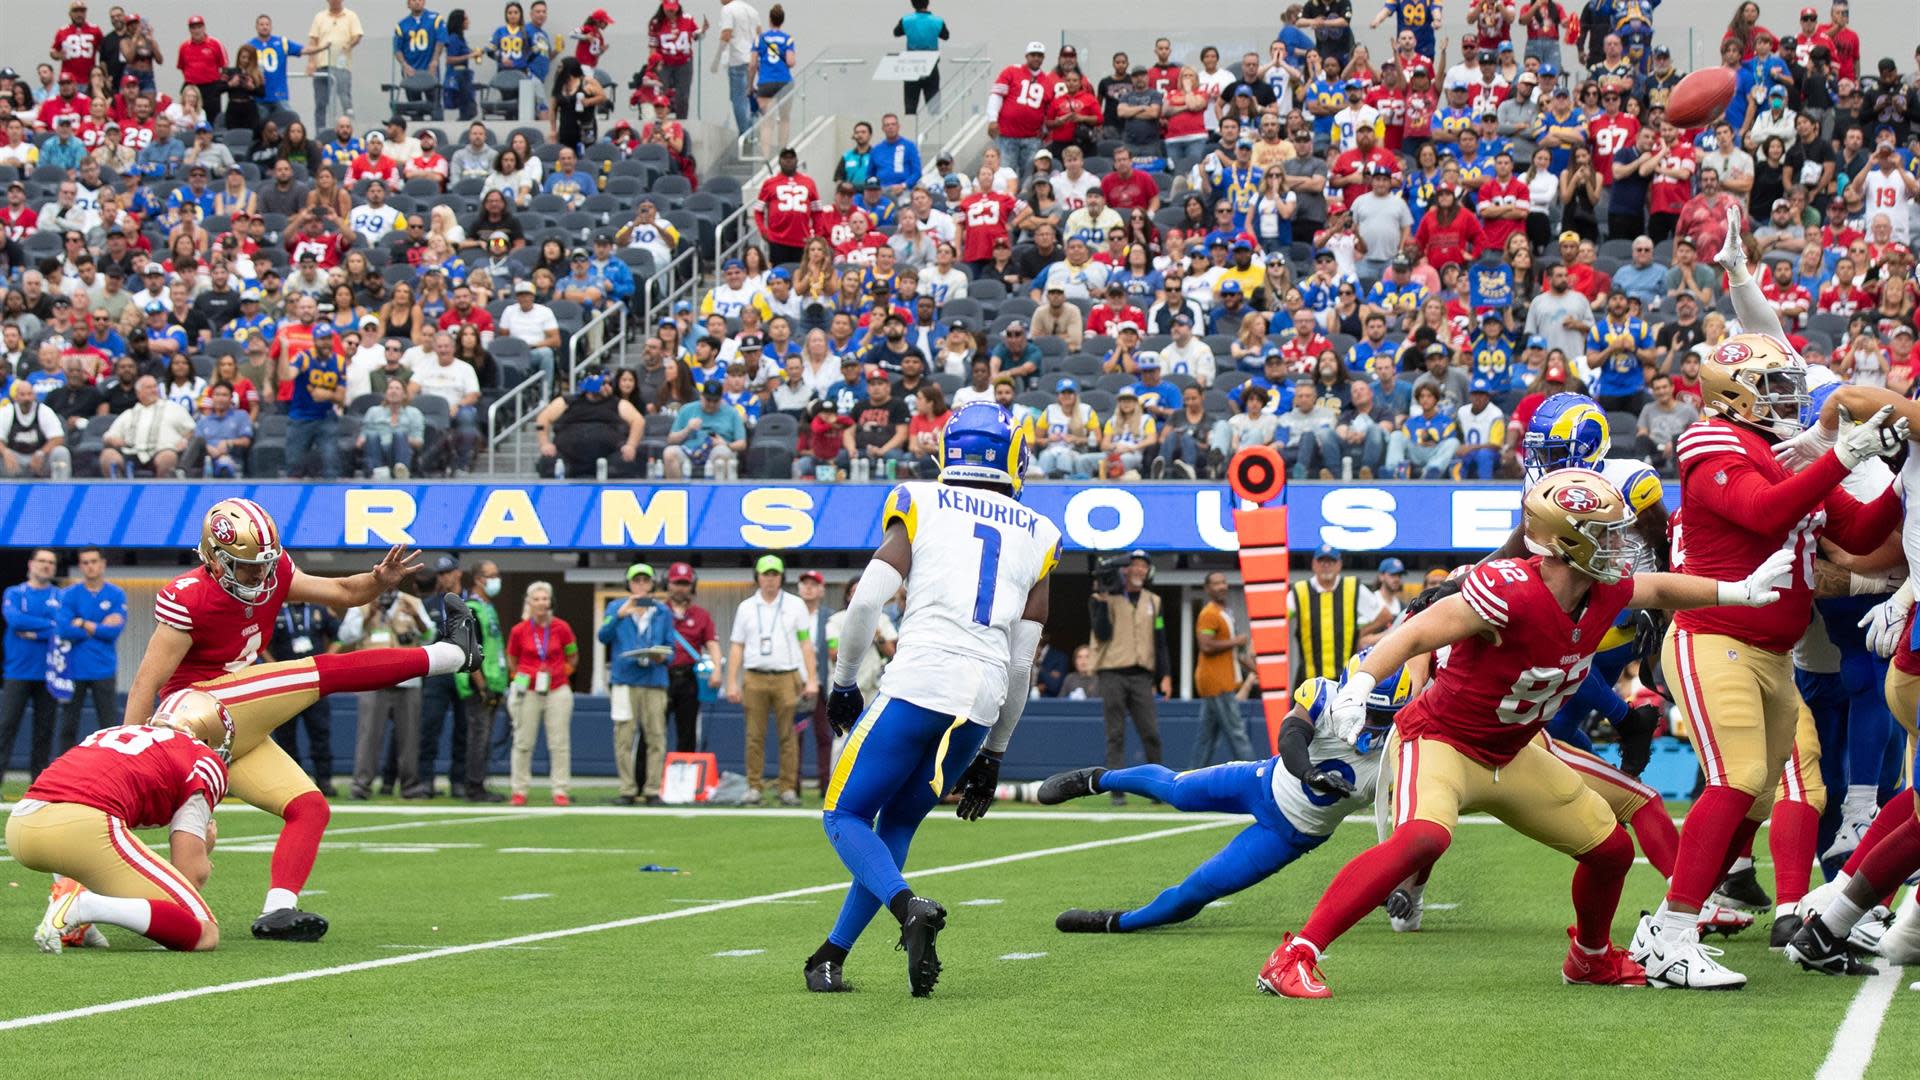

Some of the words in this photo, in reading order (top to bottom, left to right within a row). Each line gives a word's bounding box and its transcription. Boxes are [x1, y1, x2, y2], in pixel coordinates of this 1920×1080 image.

[1403, 3, 1425, 26] 99
[409, 29, 429, 52] 10
[660, 32, 690, 55] 54
[1017, 79, 1044, 109] 19
[124, 127, 153, 147] 29
[1597, 128, 1628, 155] 97
[776, 184, 809, 212] 52
[1876, 187, 1896, 208] 19
[968, 200, 999, 227] 23
[635, 230, 655, 243] 10
[1478, 350, 1506, 374] 99
[962, 471, 1000, 479] ANGELES
[344, 488, 814, 548] RAMS
[1064, 488, 1524, 551] OUSE
[938, 488, 1039, 538] KENDRICK
[972, 522, 1003, 627] 1
[1486, 558, 1529, 582] 82
[175, 577, 200, 591] 4
[223, 632, 262, 673] 4
[1496, 652, 1596, 725] 82
